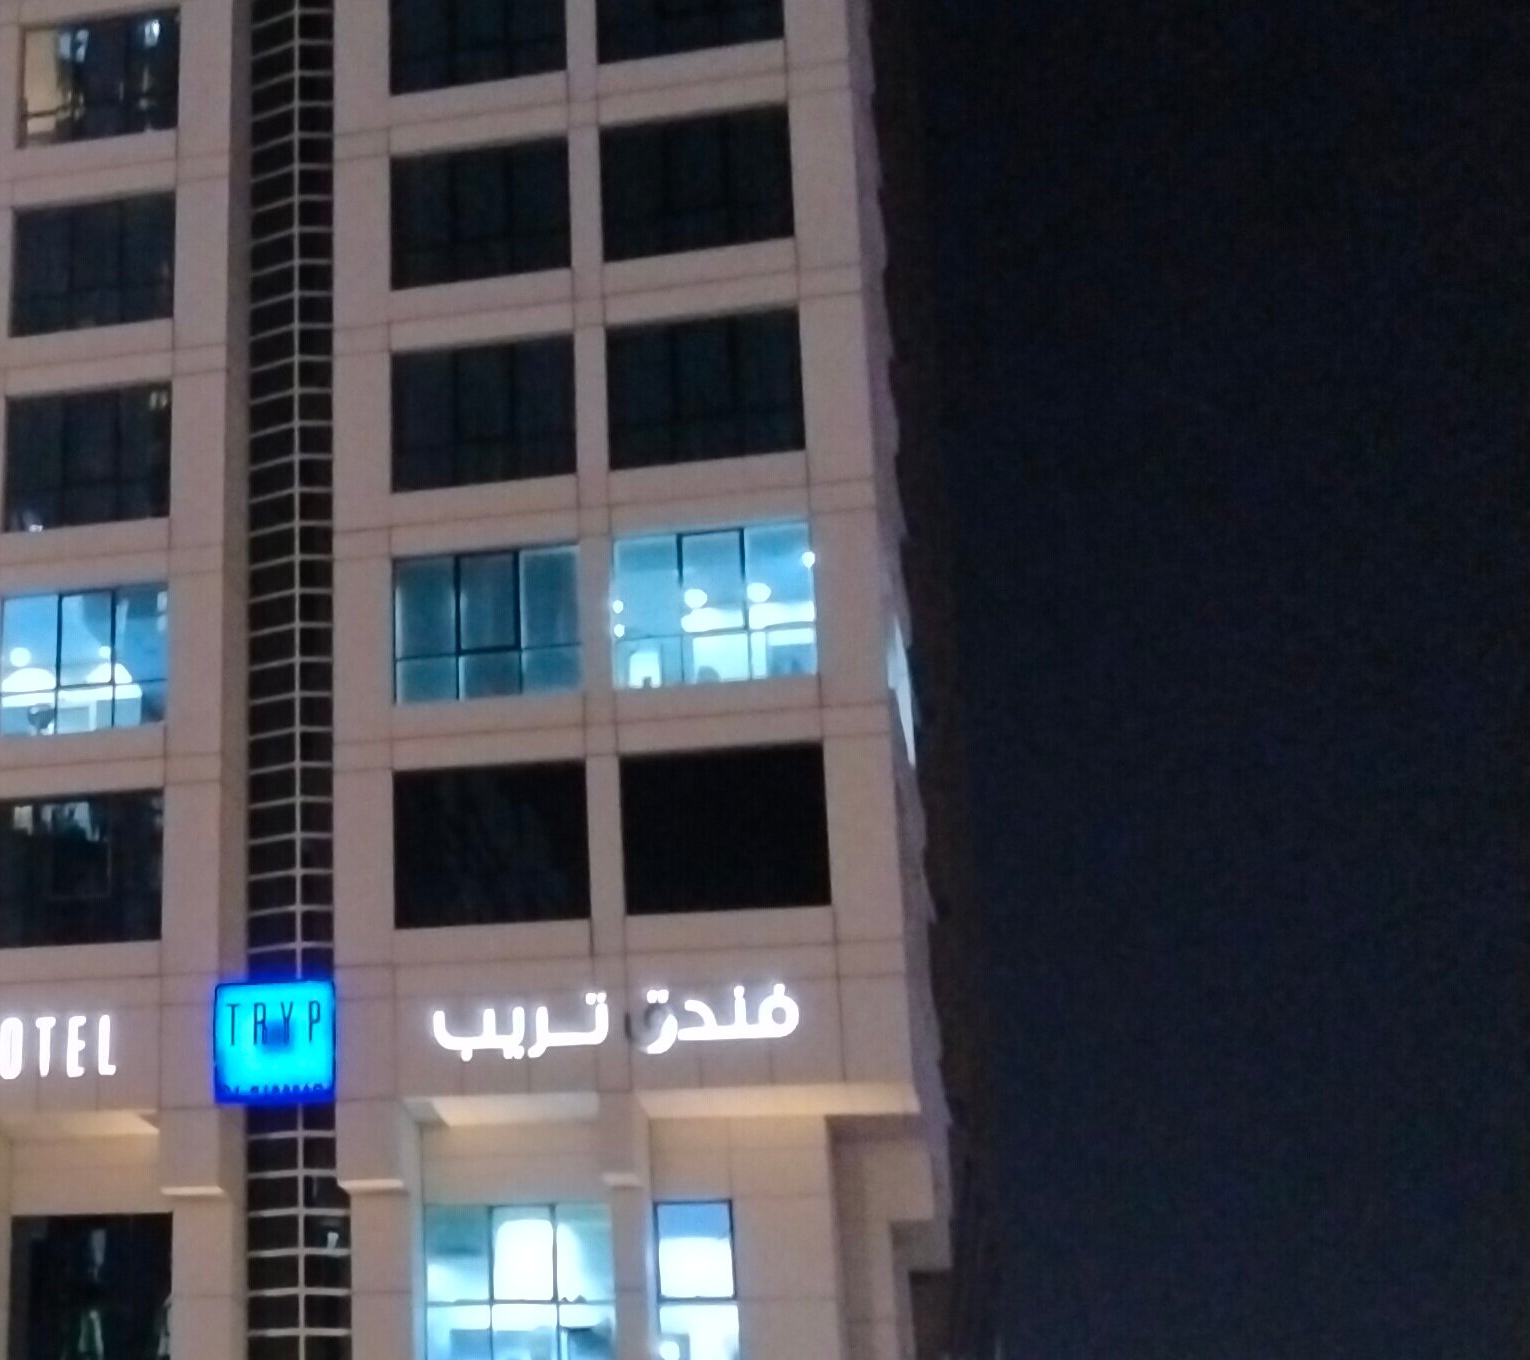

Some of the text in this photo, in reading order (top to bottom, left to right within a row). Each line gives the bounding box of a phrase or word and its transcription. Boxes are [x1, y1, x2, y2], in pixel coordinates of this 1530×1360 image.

[225, 999, 321, 1046] TRYP
[432, 982, 800, 1062] فندق تريب
